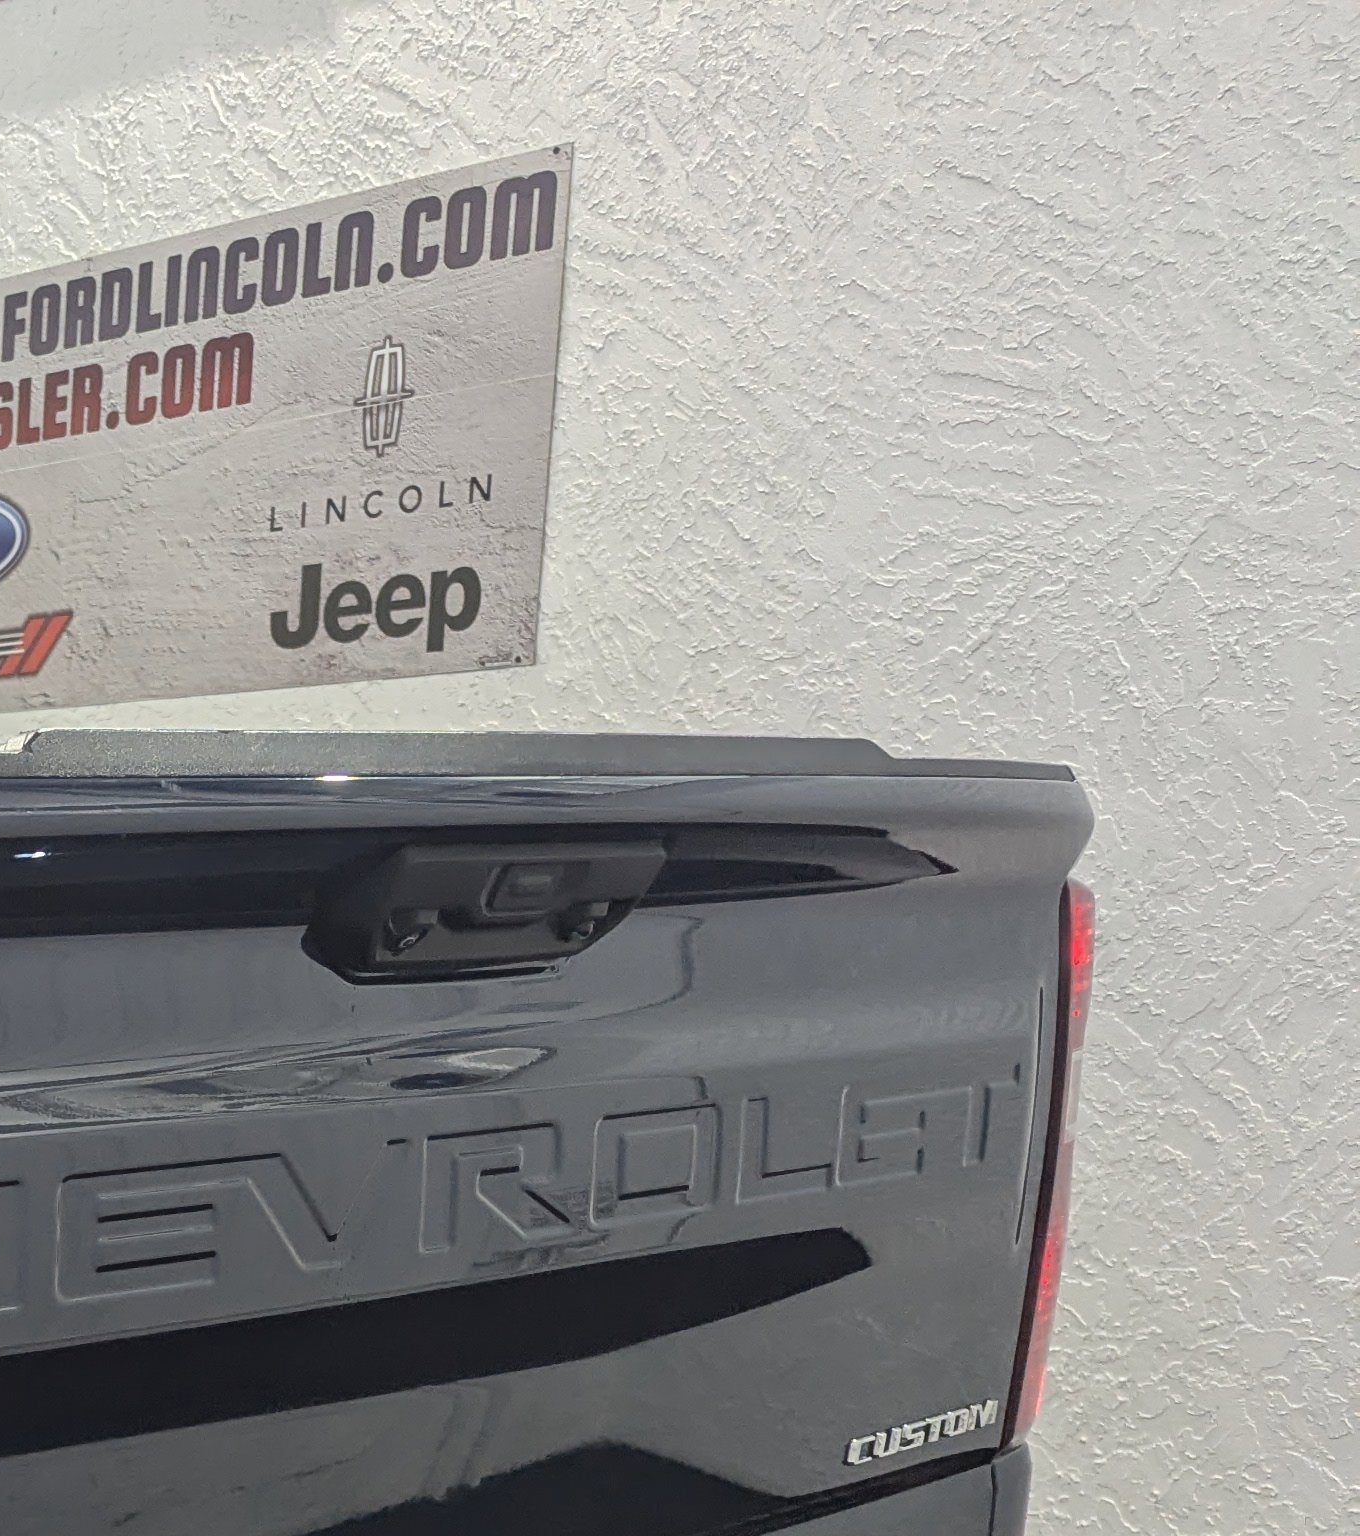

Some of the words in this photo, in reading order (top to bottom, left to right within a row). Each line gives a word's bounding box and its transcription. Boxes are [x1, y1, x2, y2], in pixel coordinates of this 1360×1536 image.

[270, 474, 492, 532] LINCOLN
[270, 563, 482, 653] Jeep
[846, 1400, 999, 1465] CUSTOM
